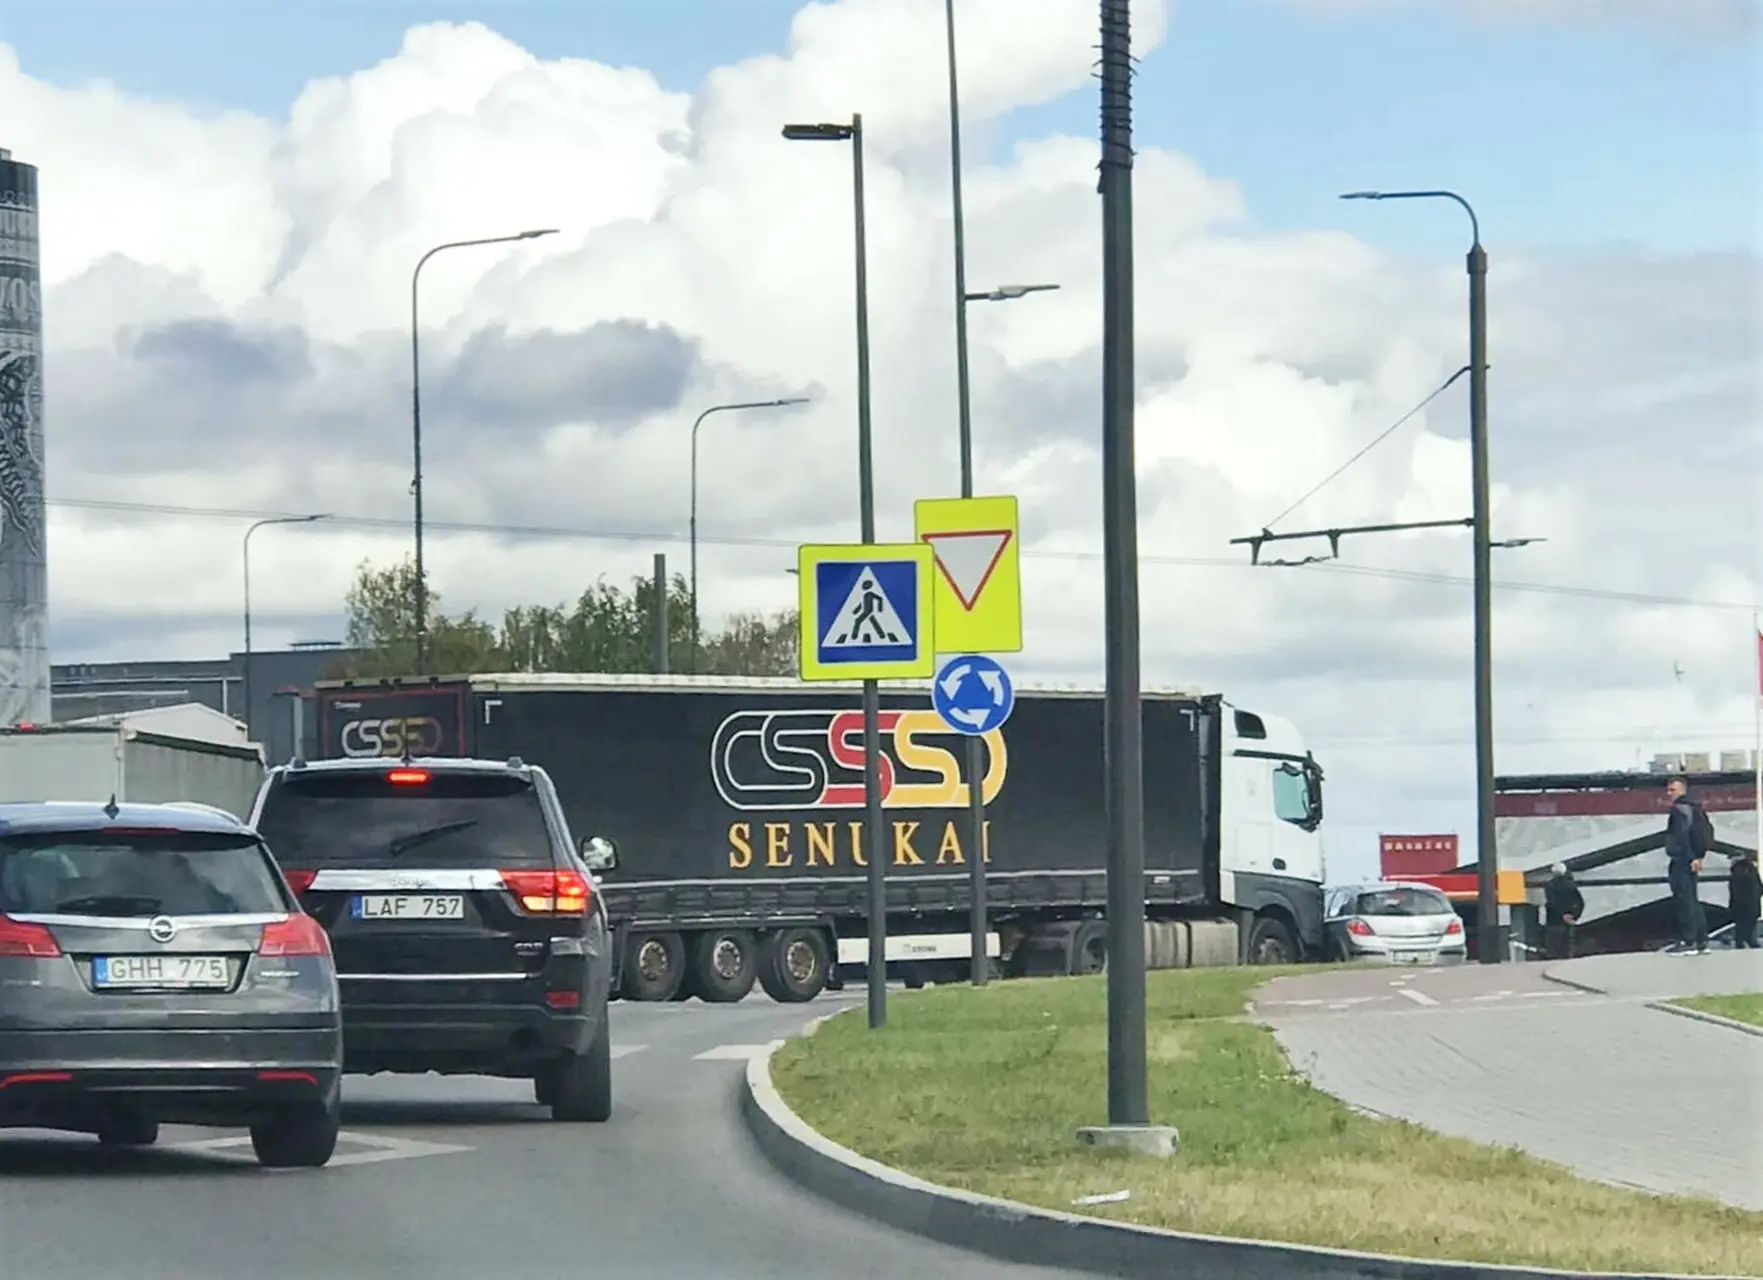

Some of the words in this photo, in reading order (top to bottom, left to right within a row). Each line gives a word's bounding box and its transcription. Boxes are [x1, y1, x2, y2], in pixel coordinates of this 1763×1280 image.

[364, 897, 408, 916] LAF
[422, 897, 460, 916] 757
[111, 959, 163, 979] GHH
[178, 959, 223, 979] 775
